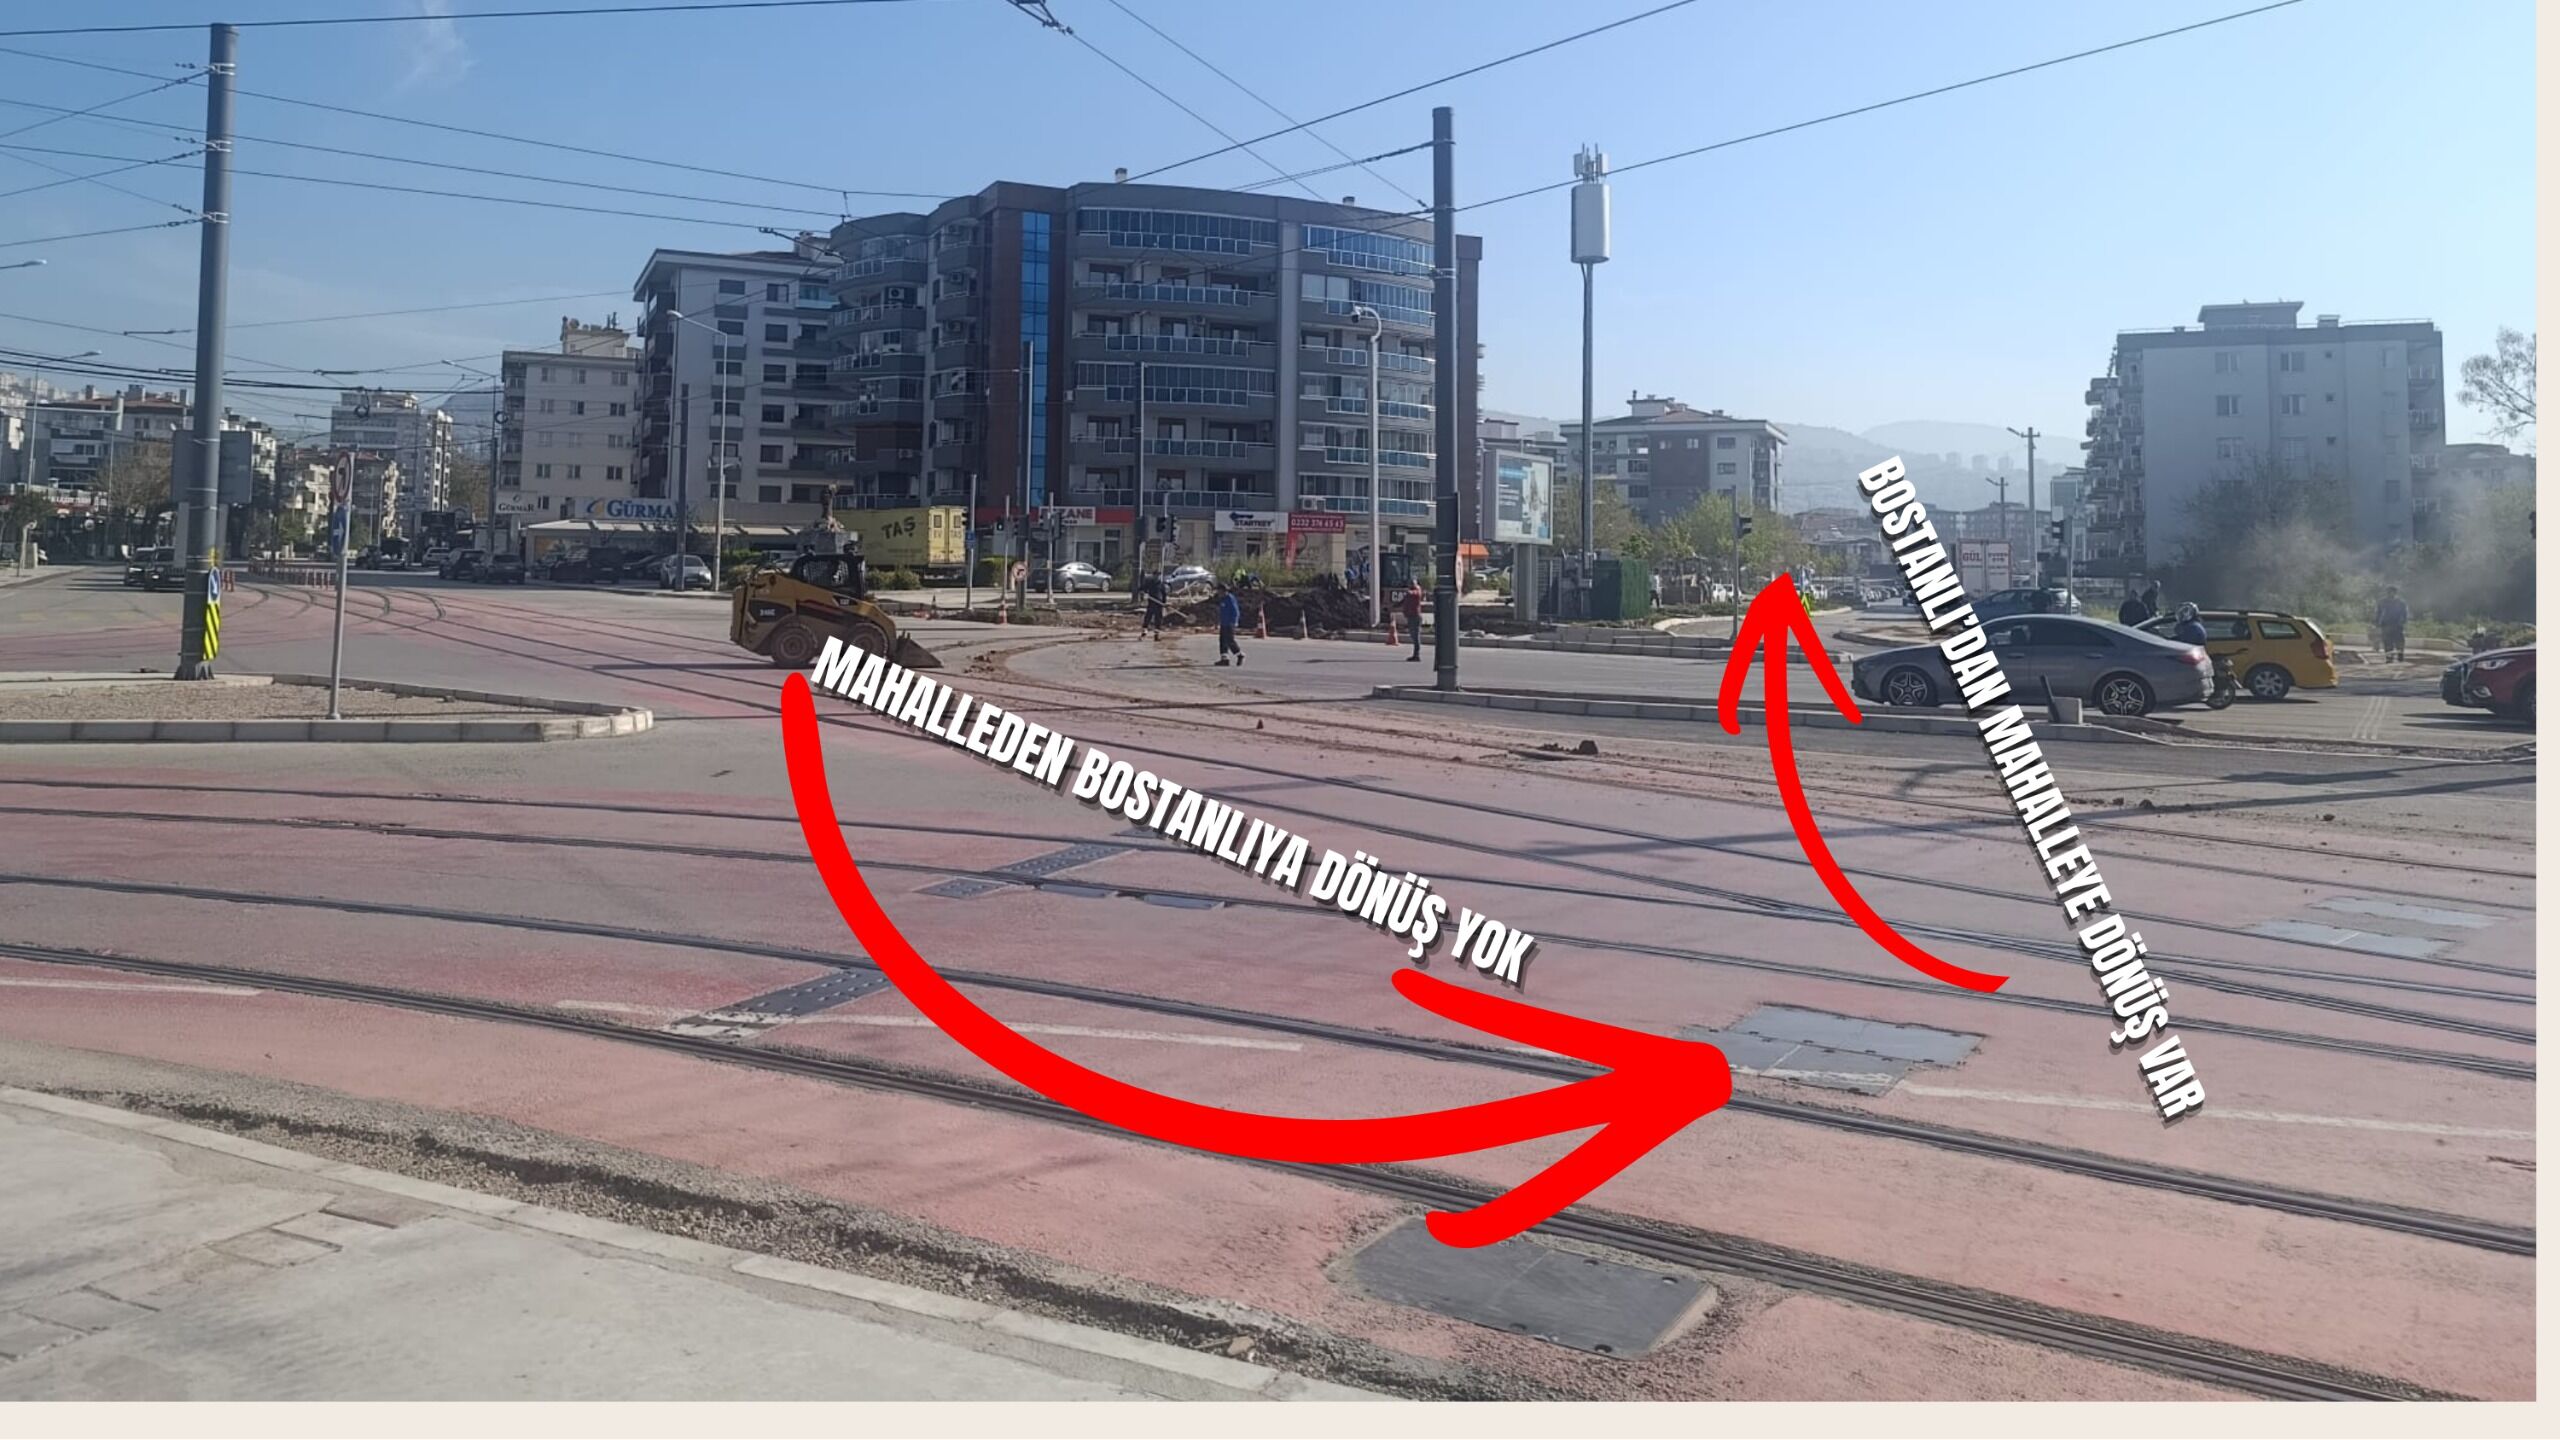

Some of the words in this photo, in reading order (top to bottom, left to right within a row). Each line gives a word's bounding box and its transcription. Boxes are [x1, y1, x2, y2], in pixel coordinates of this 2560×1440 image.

[607, 499, 688, 518] GÜRMA
[882, 516, 916, 539] TAŞ
[1962, 550, 1983, 561] GÜL
